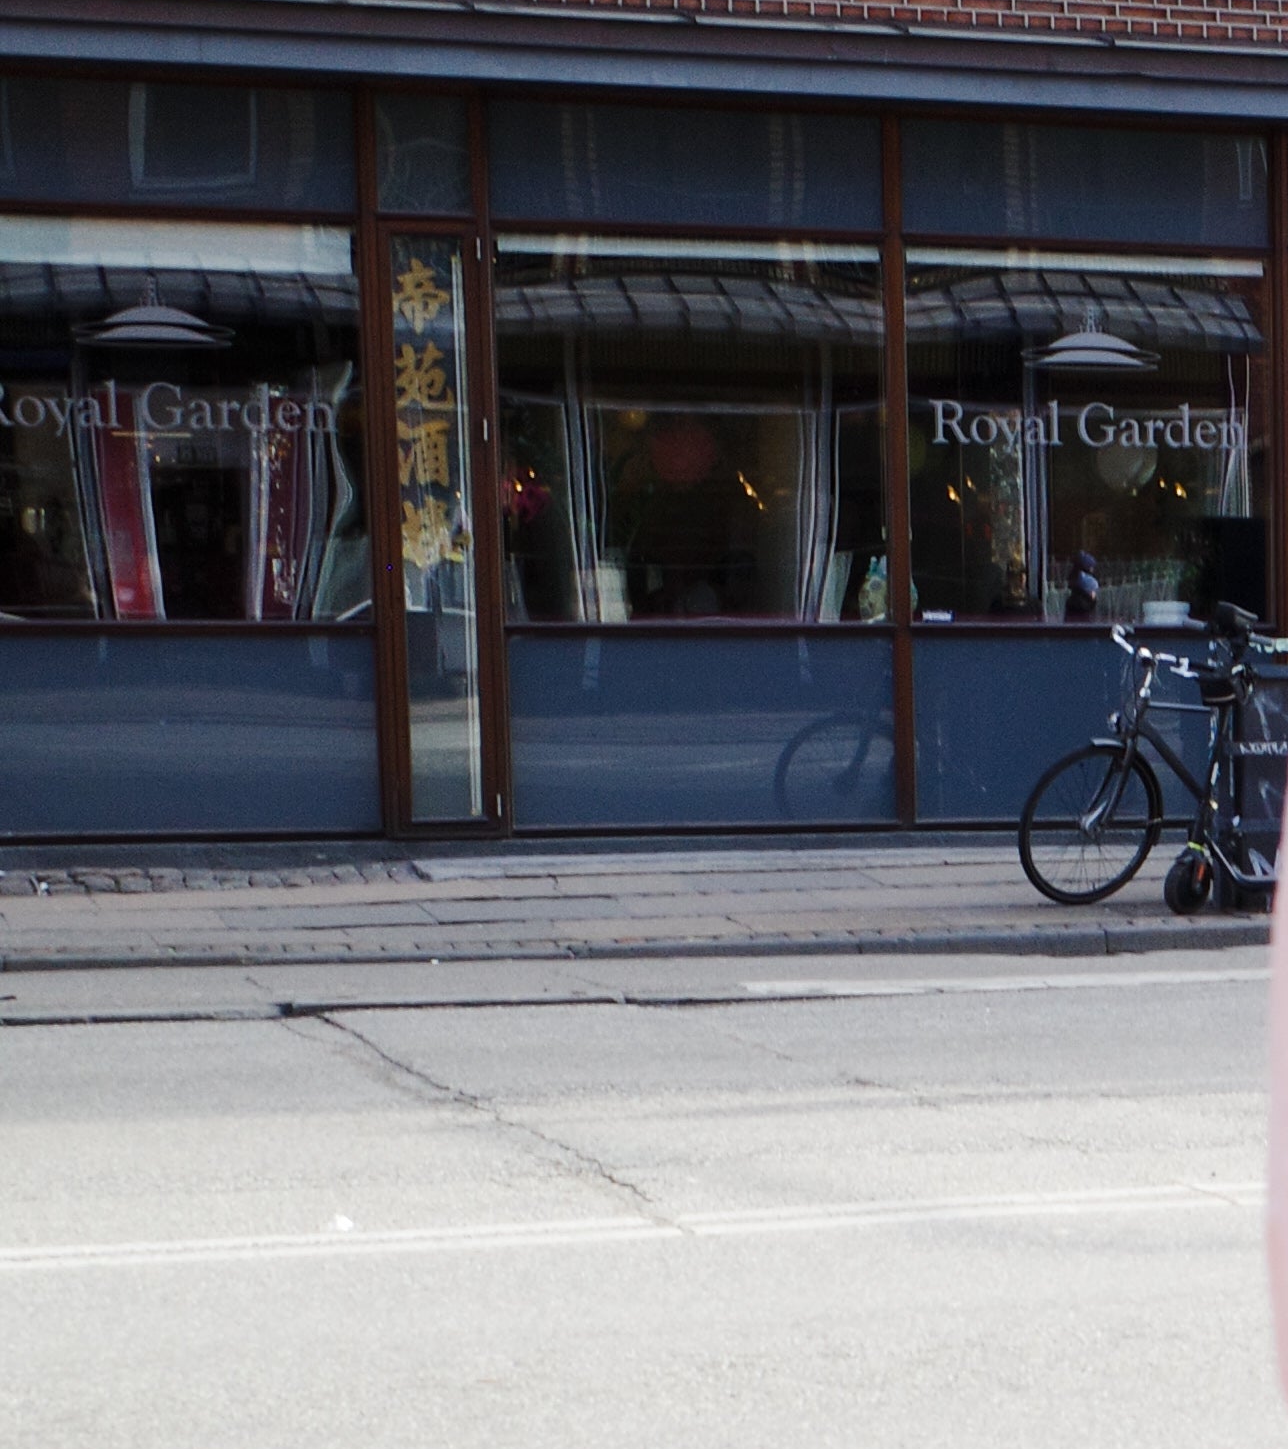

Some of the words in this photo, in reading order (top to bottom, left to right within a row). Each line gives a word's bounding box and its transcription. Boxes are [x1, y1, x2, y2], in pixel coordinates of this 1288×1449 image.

[0, 379, 122, 436] oyal
[142, 381, 338, 432] Garden
[928, 399, 1064, 452] Royal
[1077, 402, 1246, 450] Garden
